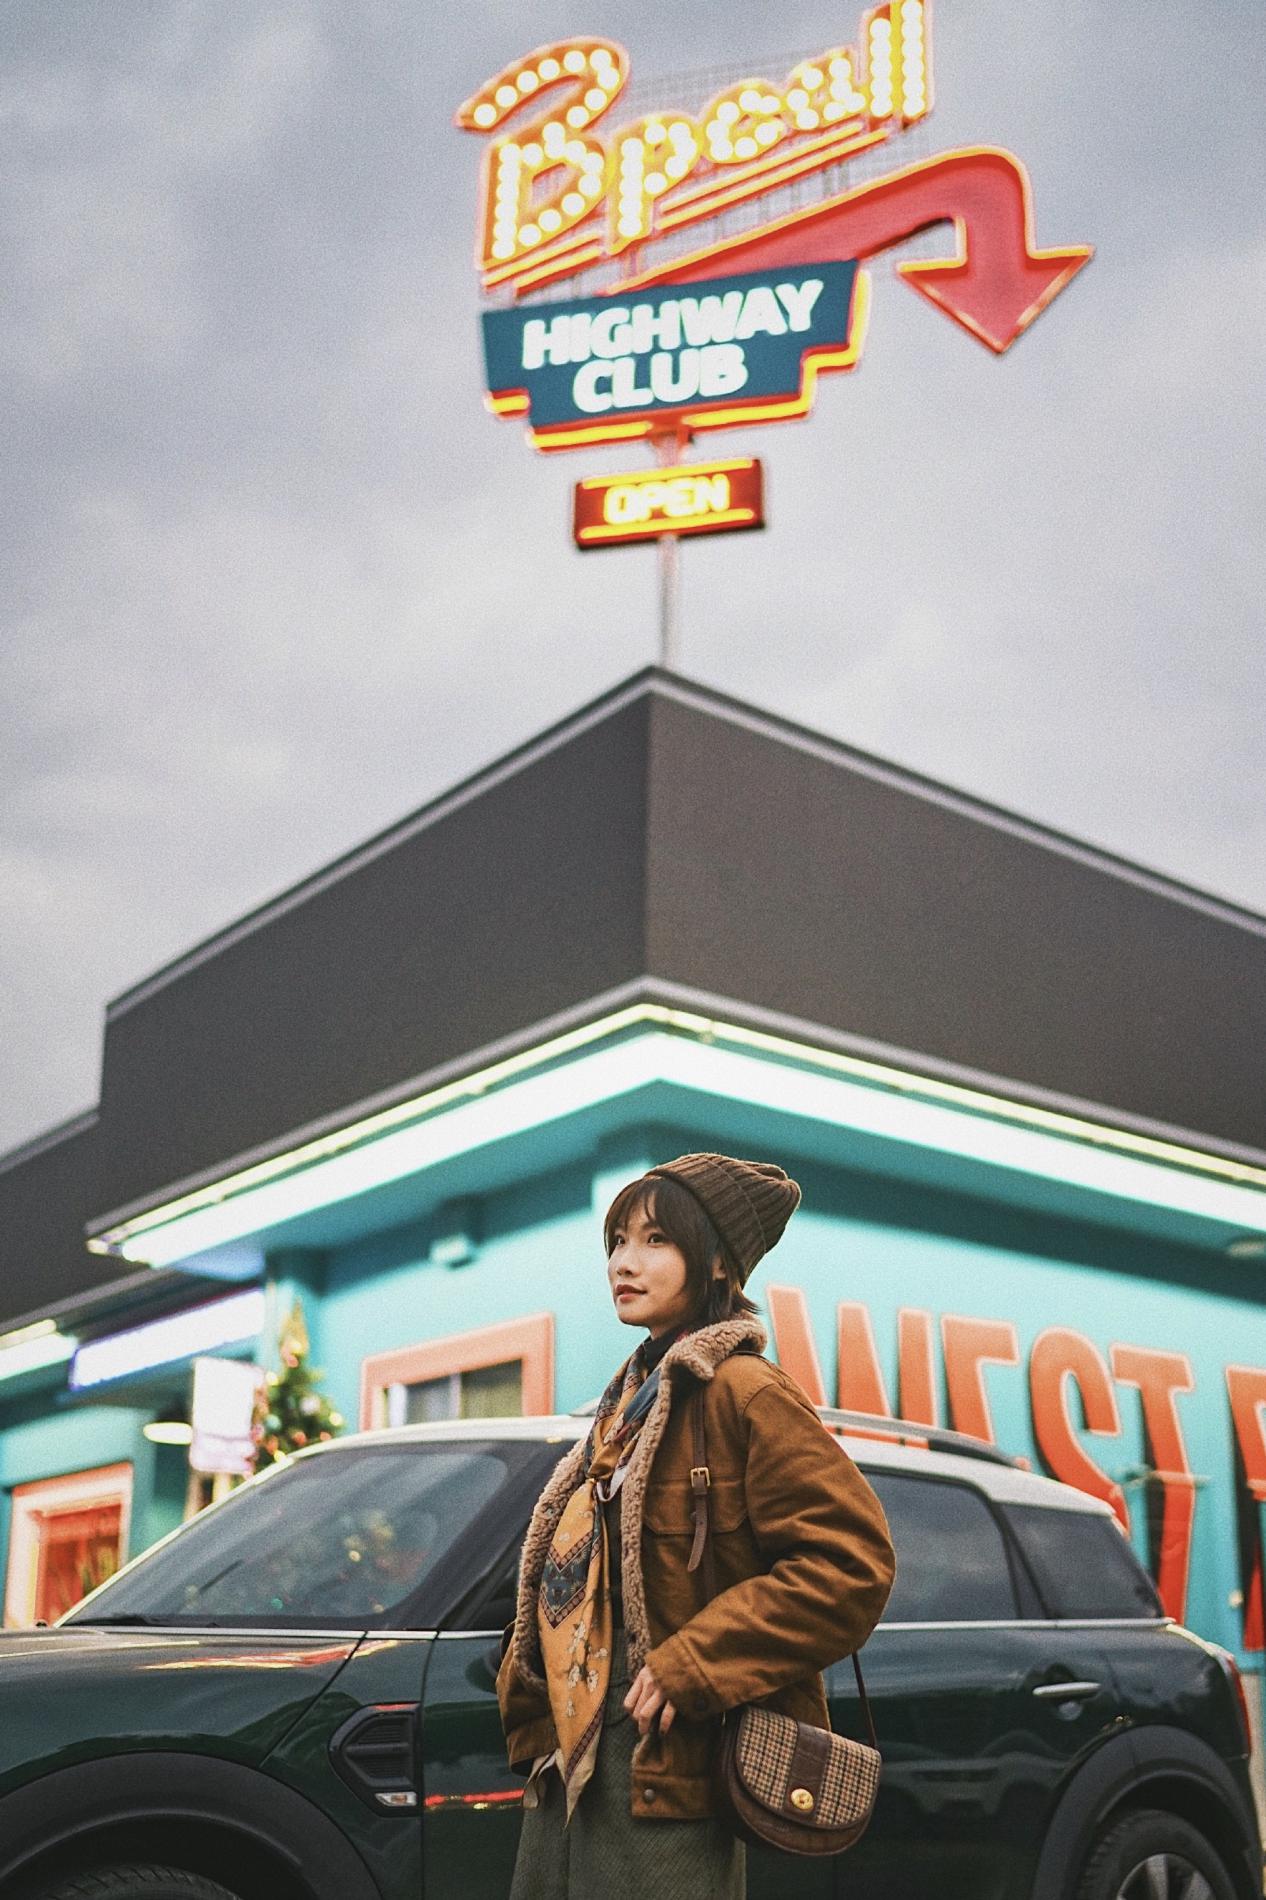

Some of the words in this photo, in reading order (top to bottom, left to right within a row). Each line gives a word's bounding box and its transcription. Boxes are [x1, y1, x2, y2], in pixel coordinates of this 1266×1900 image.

[522, 279, 824, 369] HIGHWAY
[572, 343, 749, 413] CLUB
[602, 472, 731, 526] OPEN
